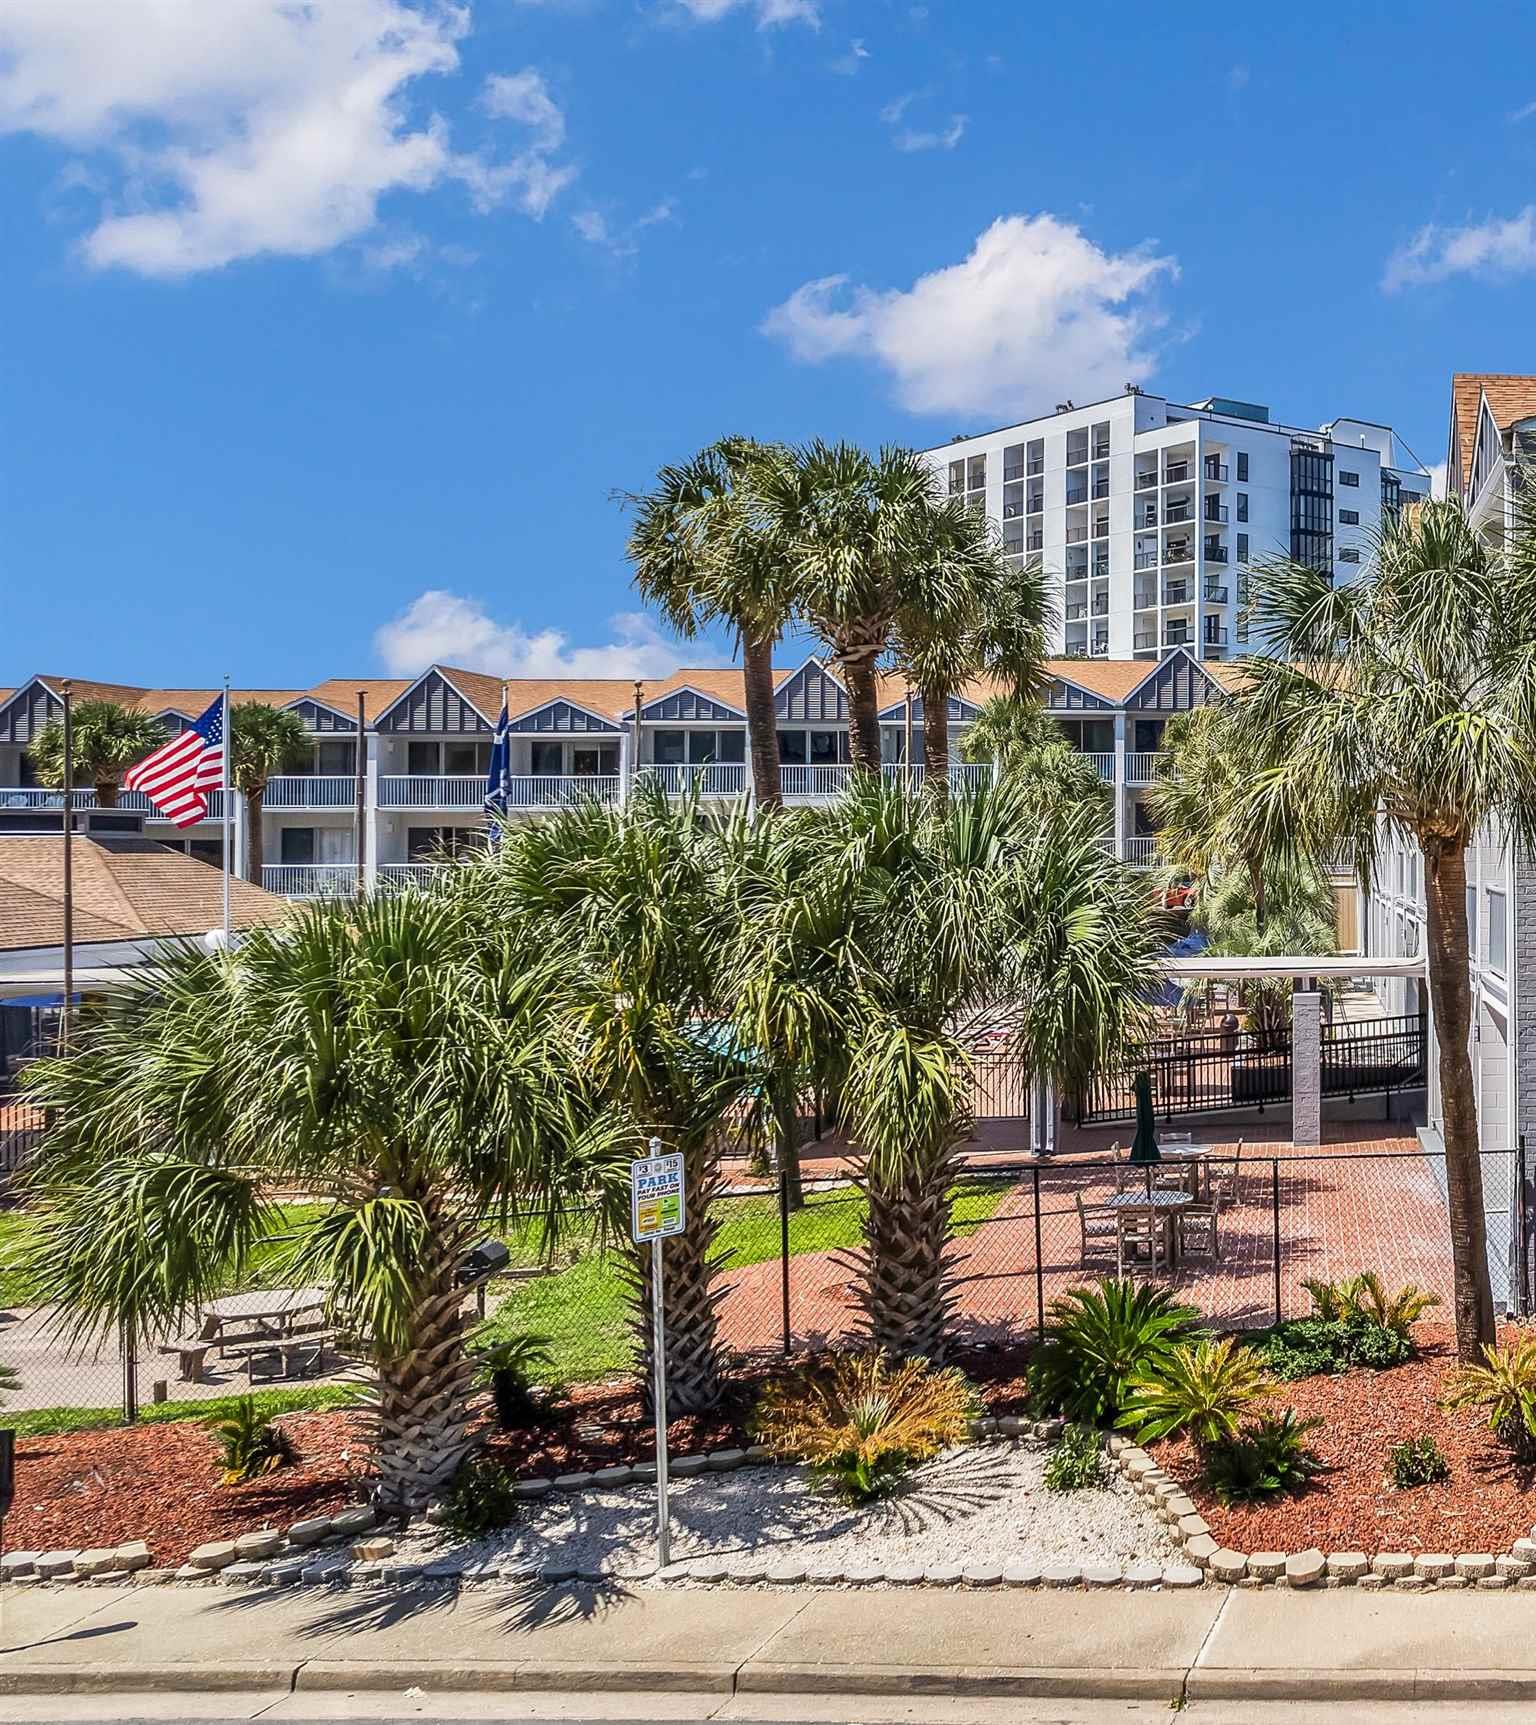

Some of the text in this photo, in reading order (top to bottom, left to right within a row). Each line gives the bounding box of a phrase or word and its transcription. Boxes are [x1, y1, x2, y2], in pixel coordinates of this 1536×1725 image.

[638, 1173, 679, 1188] PARK
[637, 1188, 680, 1200] YOUR PHONE
